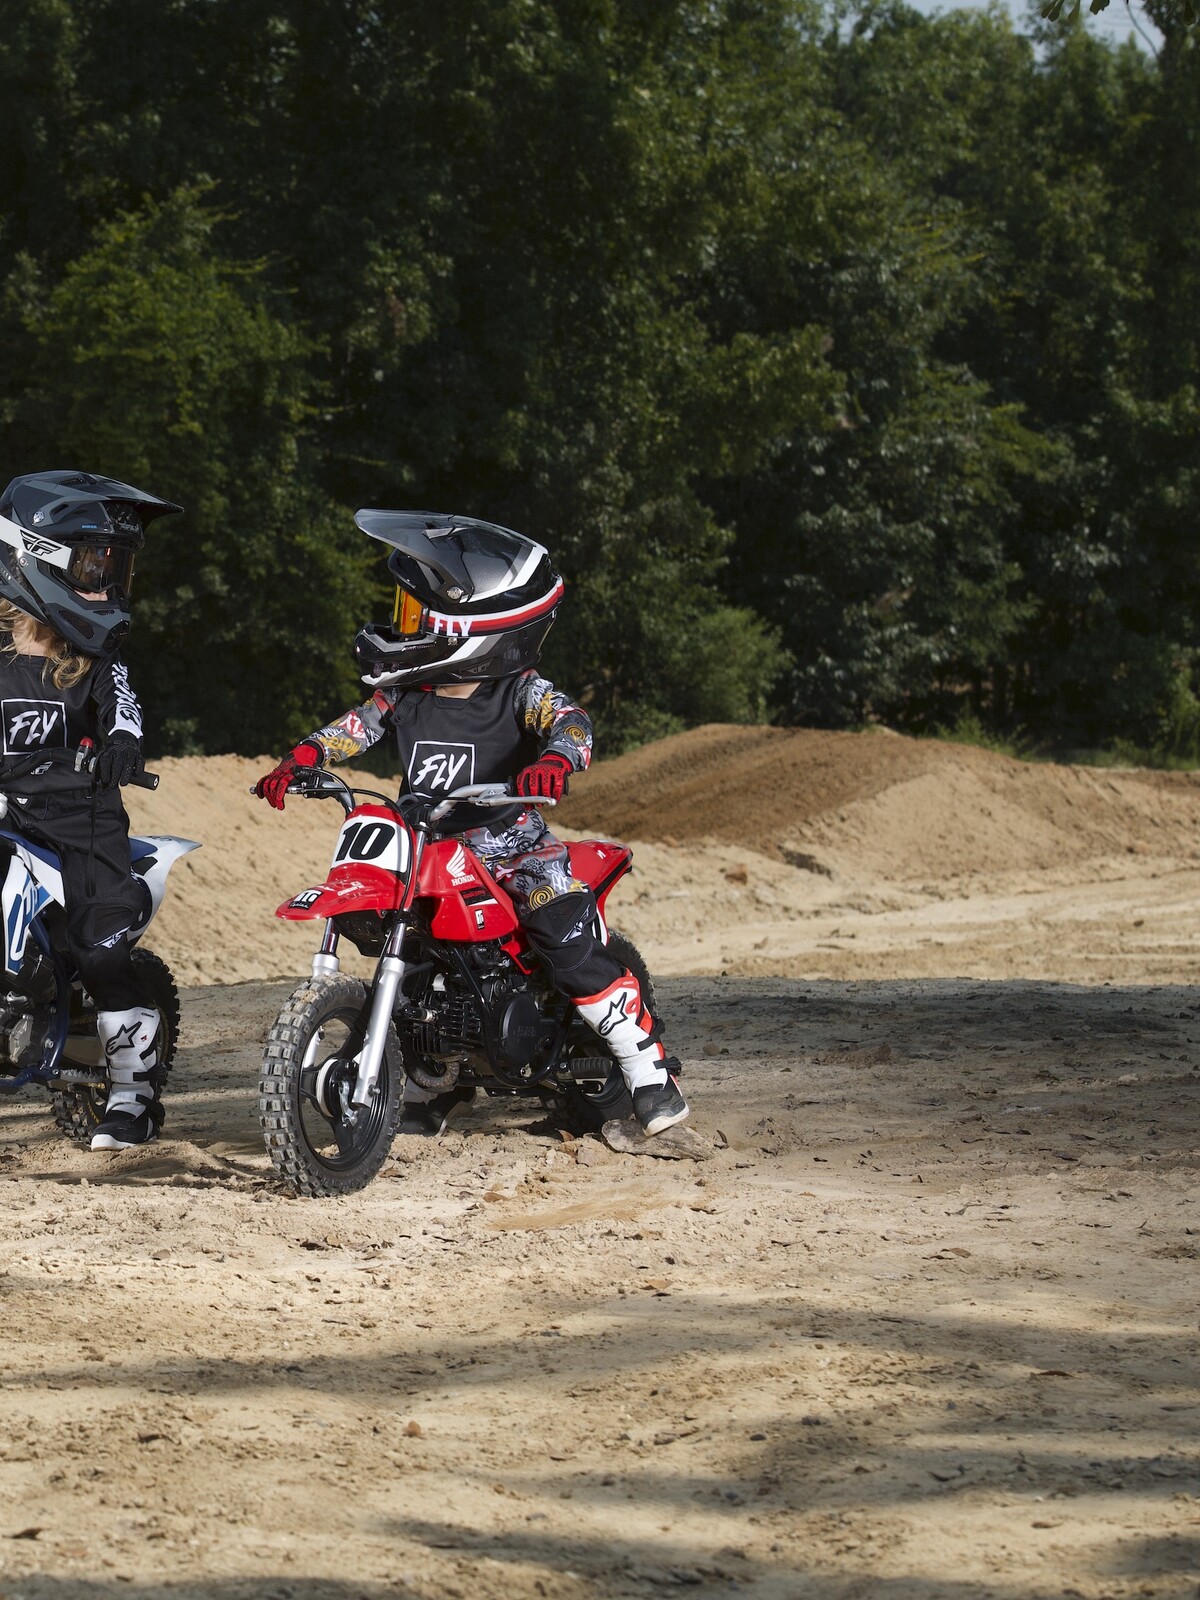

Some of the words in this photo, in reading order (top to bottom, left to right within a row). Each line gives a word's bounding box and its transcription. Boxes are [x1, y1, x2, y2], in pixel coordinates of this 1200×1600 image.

[432, 614, 473, 637] FLY
[9, 710, 60, 746] FLY
[413, 752, 467, 791] FLY
[335, 822, 396, 861] 10
[451, 874, 476, 887] HONDA
